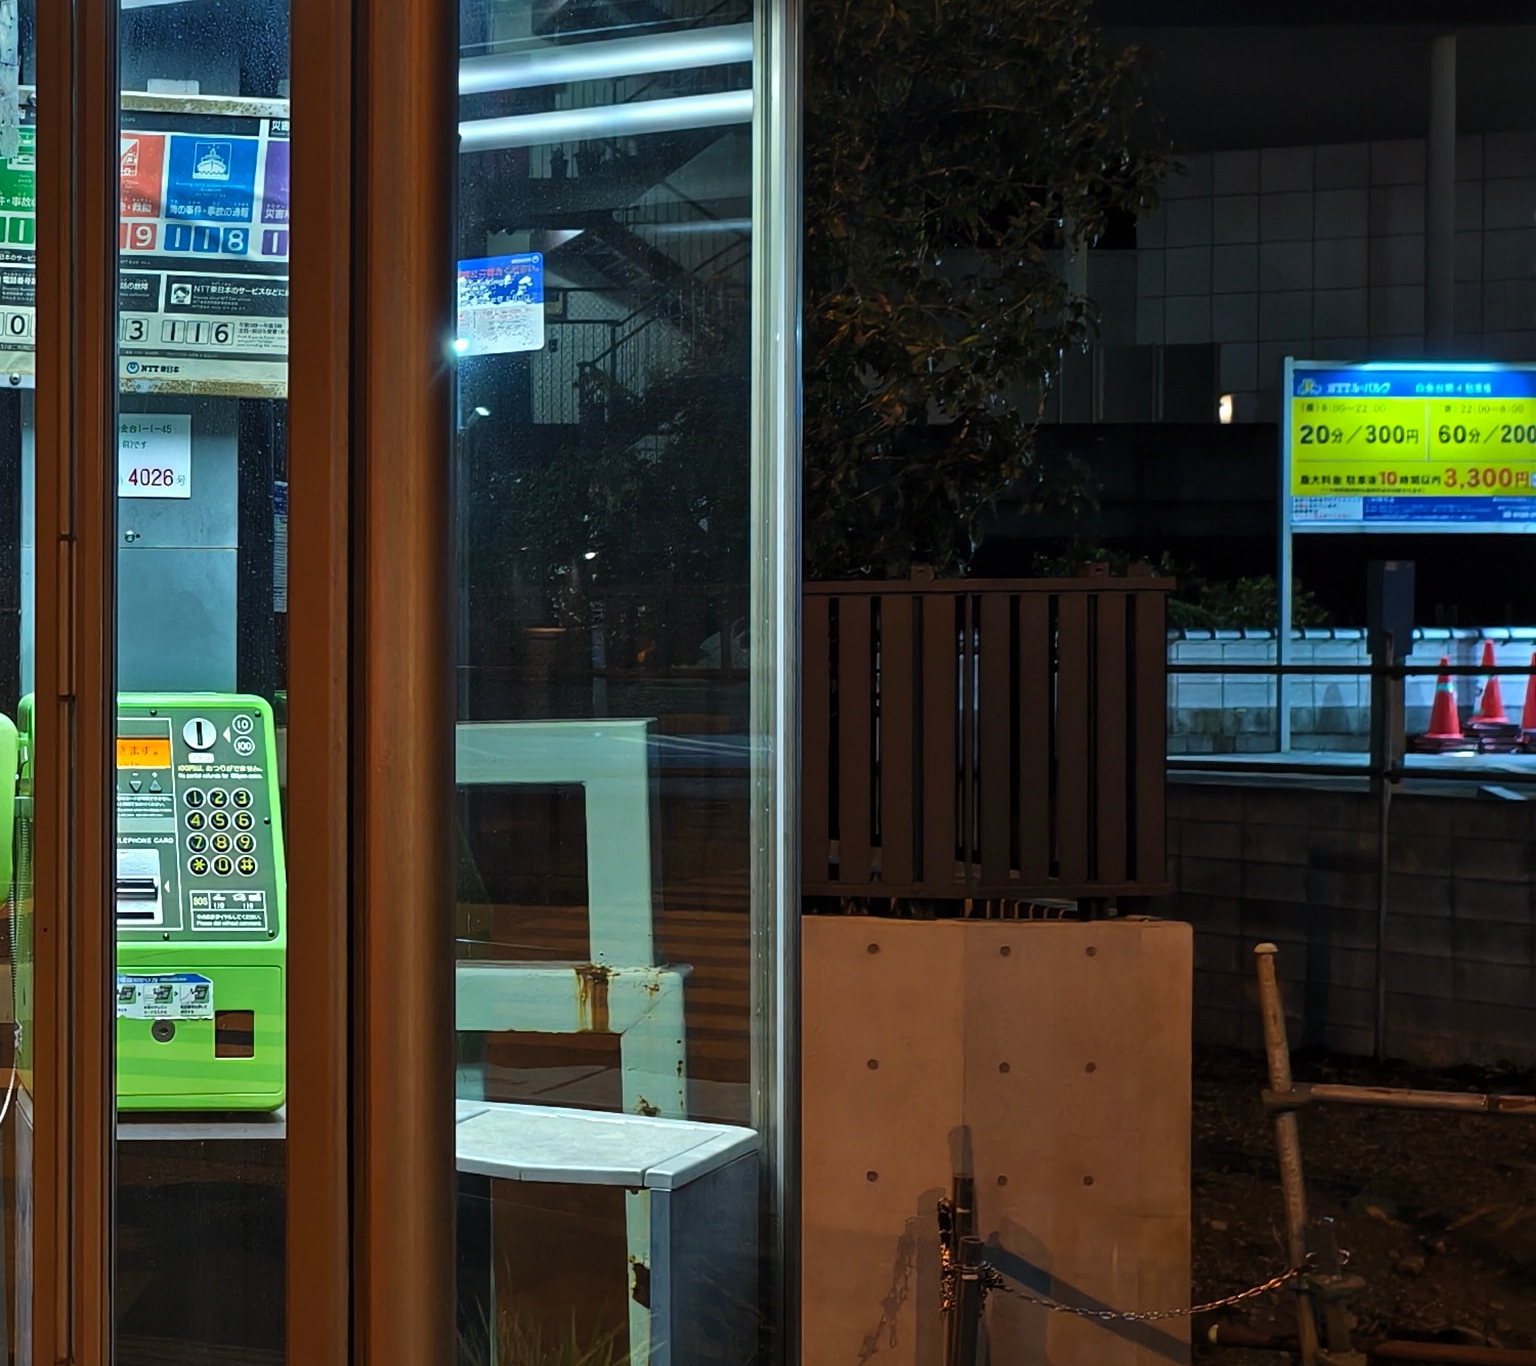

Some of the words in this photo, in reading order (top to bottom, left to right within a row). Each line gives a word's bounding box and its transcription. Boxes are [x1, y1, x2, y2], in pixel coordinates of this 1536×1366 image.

[174, 227, 244, 252] 118
[171, 321, 229, 344] 116
[236, 719, 249, 730] 10
[237, 741, 252, 751] 100
[214, 791, 224, 804] 2
[237, 791, 247, 804] 3
[190, 814, 201, 827] 4
[215, 814, 225, 827] 5
[238, 814, 249, 827] 6
[194, 836, 203, 849] 7
[216, 836, 227, 850] 8
[240, 836, 251, 850] 9
[218, 858, 229, 871] 0
